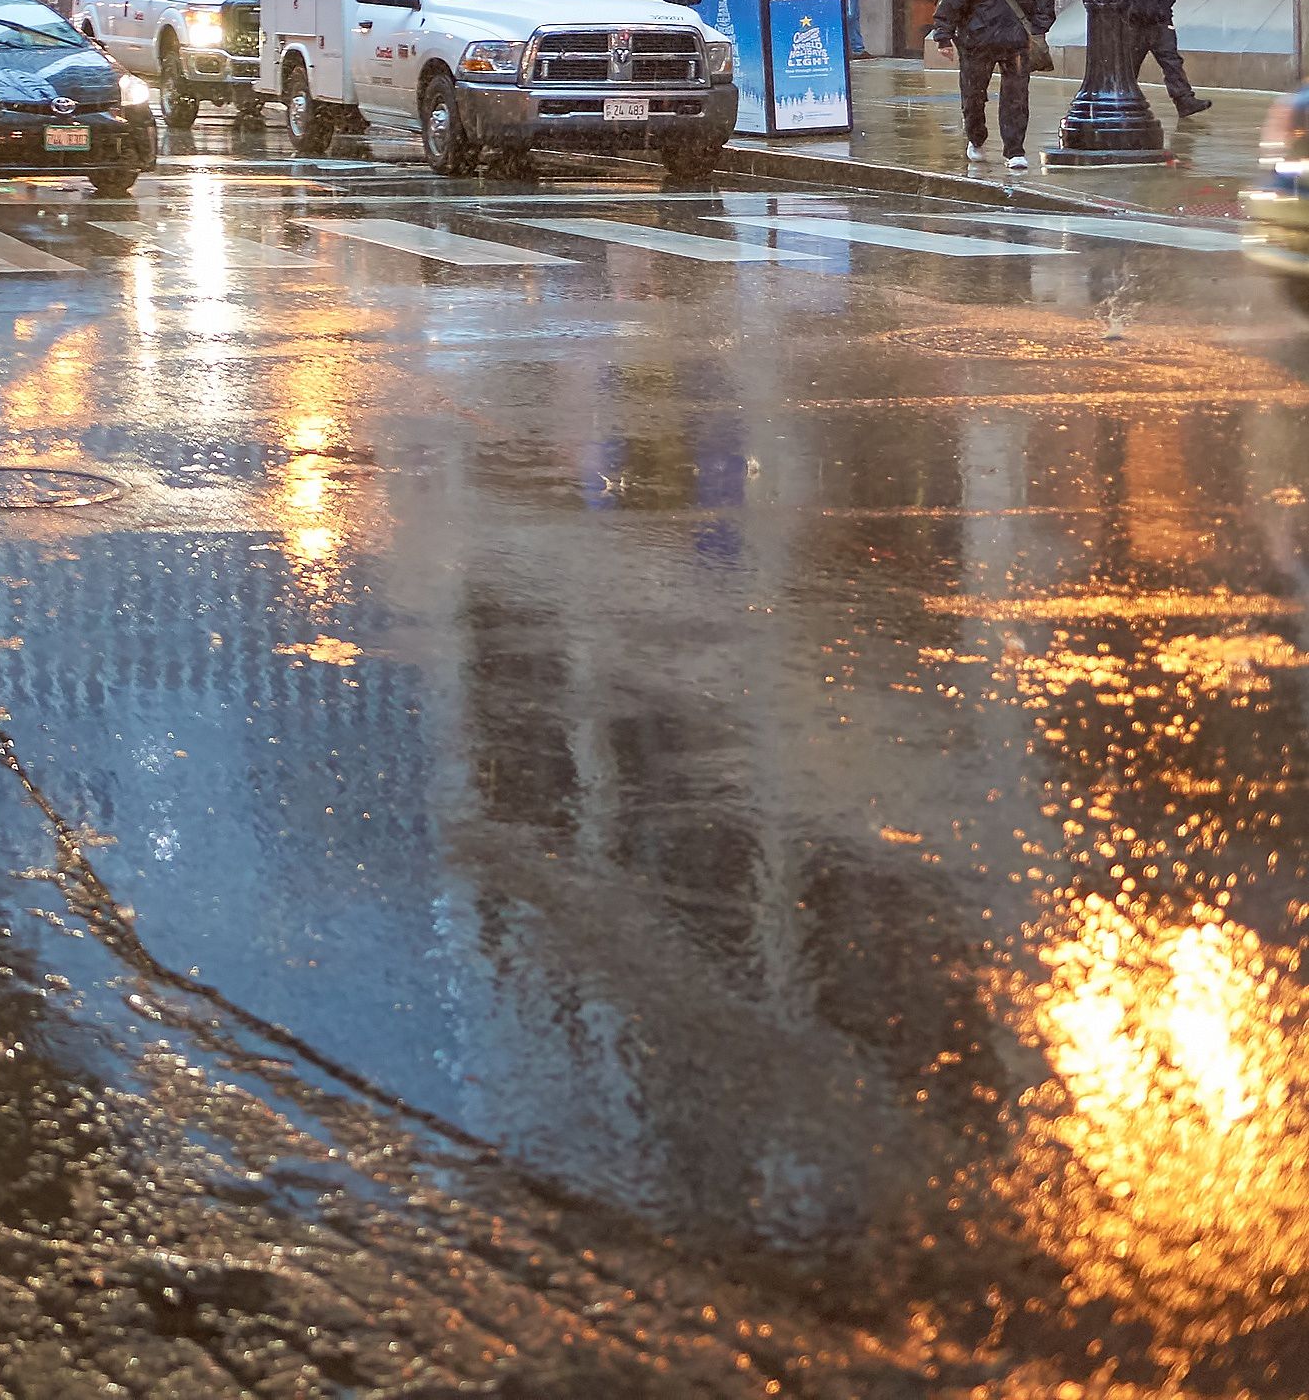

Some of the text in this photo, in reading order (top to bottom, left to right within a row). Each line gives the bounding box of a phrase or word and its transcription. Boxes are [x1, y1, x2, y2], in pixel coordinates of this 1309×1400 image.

[789, 49, 828, 59] HOLIDAYS
[788, 57, 830, 67] LIGHT
[614, 105, 624, 116] 24
[628, 105, 644, 116] 483
